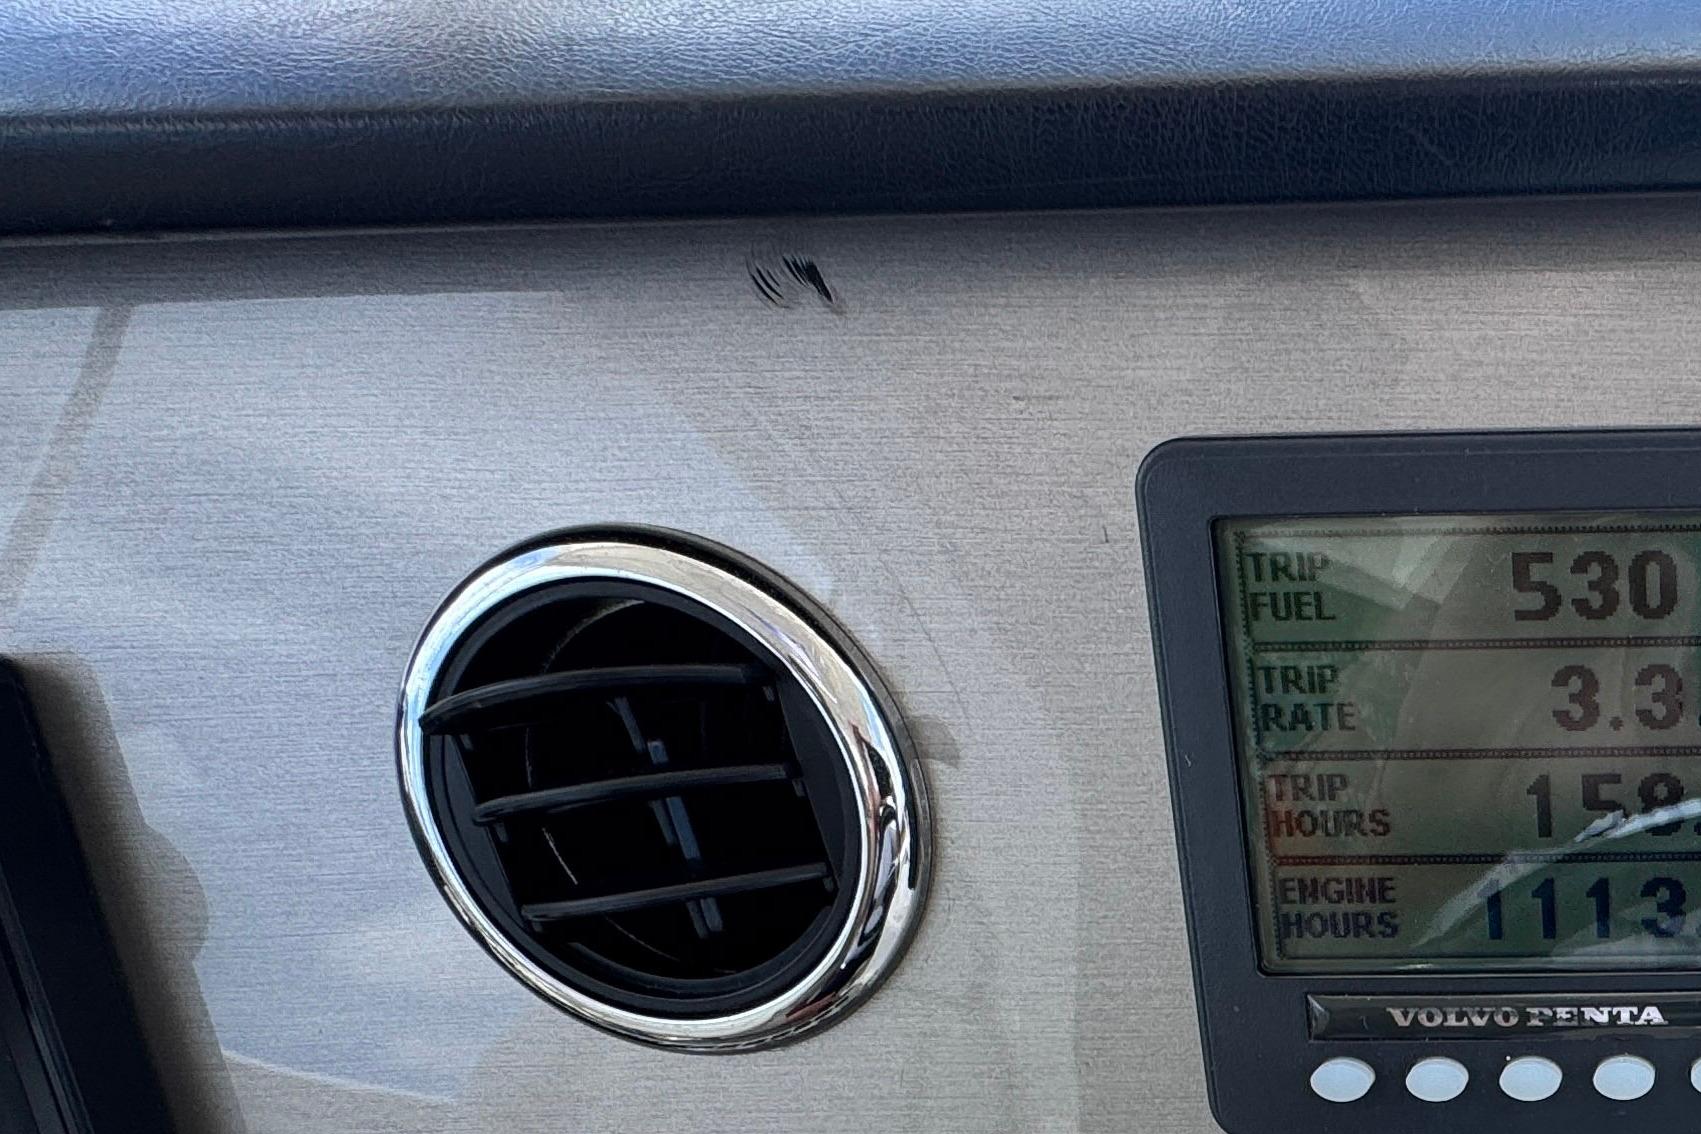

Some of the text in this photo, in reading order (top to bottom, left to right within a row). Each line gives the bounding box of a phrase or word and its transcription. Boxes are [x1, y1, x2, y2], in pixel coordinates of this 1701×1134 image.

[1246, 552, 1331, 582] TRIP
[1511, 549, 1678, 622] 530
[1249, 591, 1336, 621] FUEL
[1258, 665, 1339, 694] TRIP
[1551, 664, 1684, 732] 3.3
[1261, 702, 1356, 731] RATE
[1268, 773, 1349, 801] TRIP
[1271, 809, 1391, 837] HOURS
[1278, 877, 1396, 905] ENGINE
[1279, 910, 1399, 939] HOURS
[1386, 1005, 1669, 1028] VOLVO PENTA
